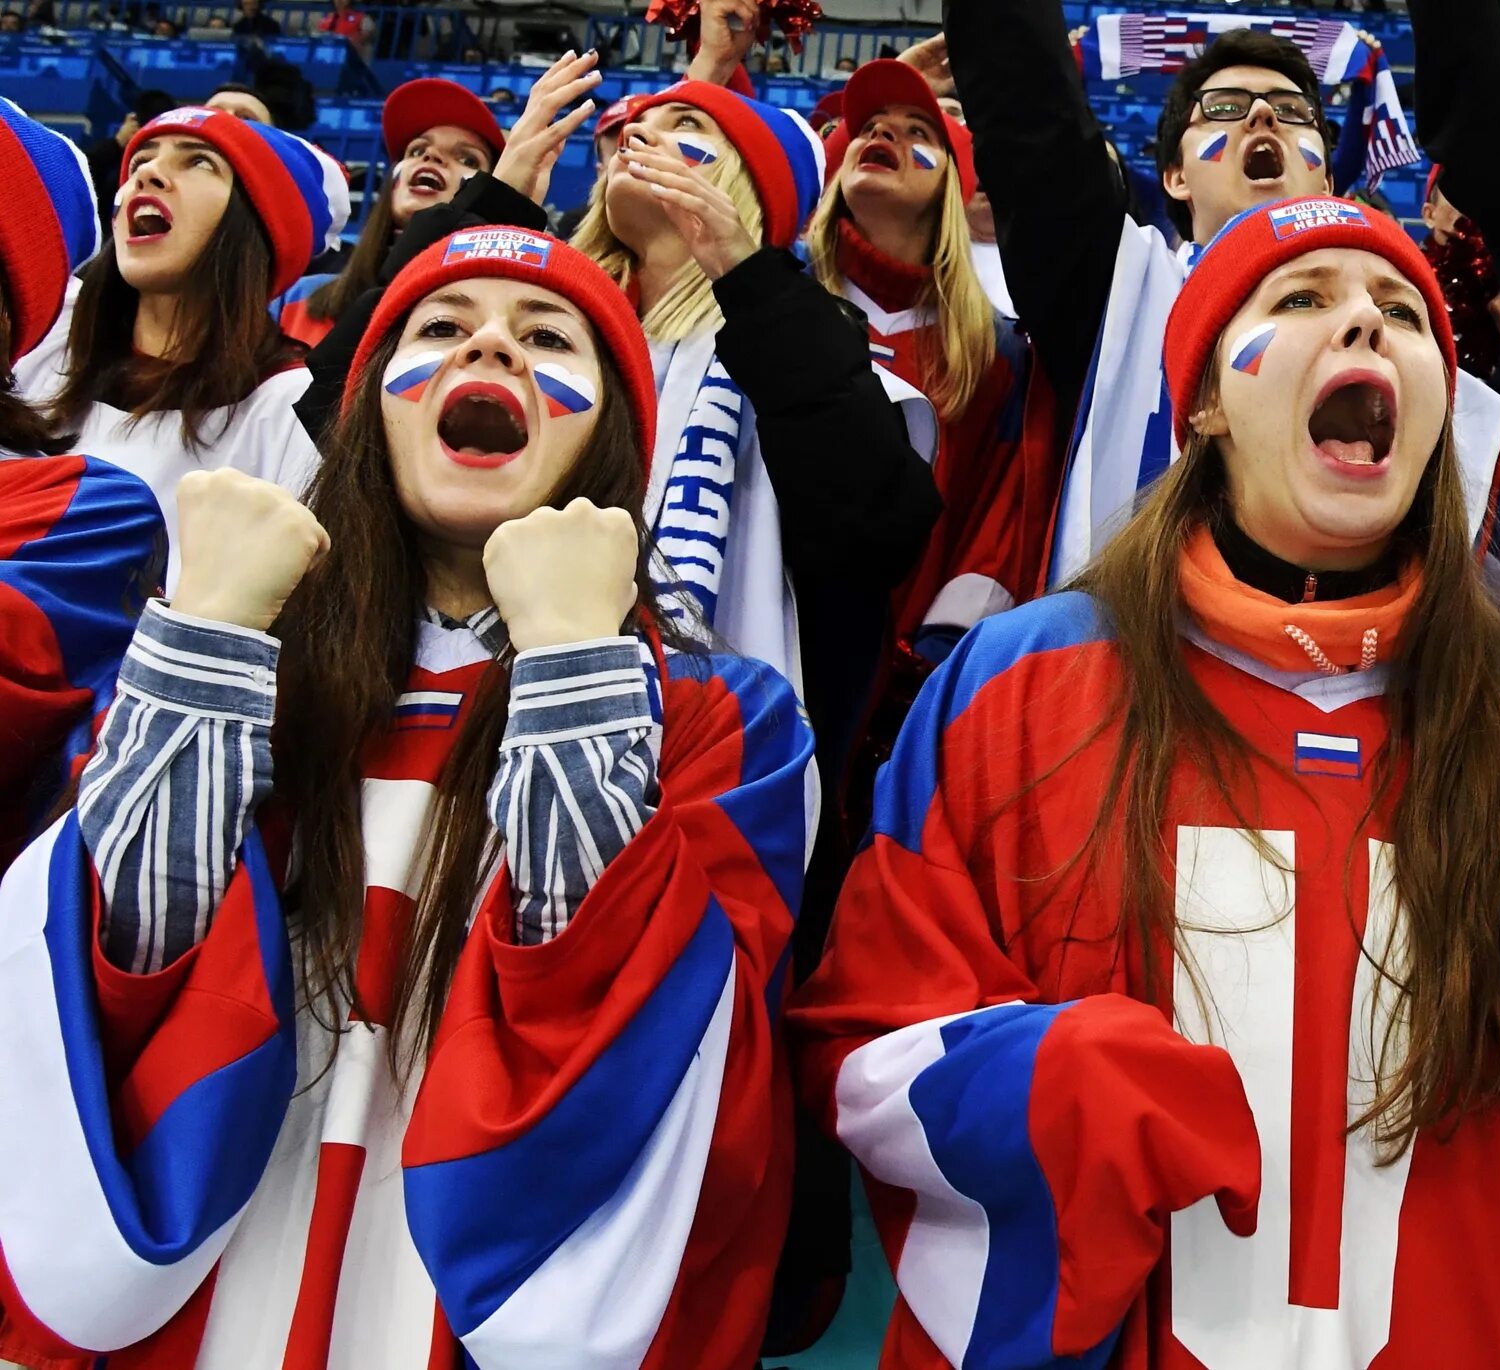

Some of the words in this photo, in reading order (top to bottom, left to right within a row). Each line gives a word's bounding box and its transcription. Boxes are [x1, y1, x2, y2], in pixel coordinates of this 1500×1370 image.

[1295, 211, 1313, 221] IN
[1293, 216, 1348, 231] HEART
[468, 232, 536, 244] #RUSSIA
[473, 241, 490, 250] IN
[495, 241, 523, 250] MY
[464, 249, 527, 260] HEART
[1171, 825, 1420, 1370] U
